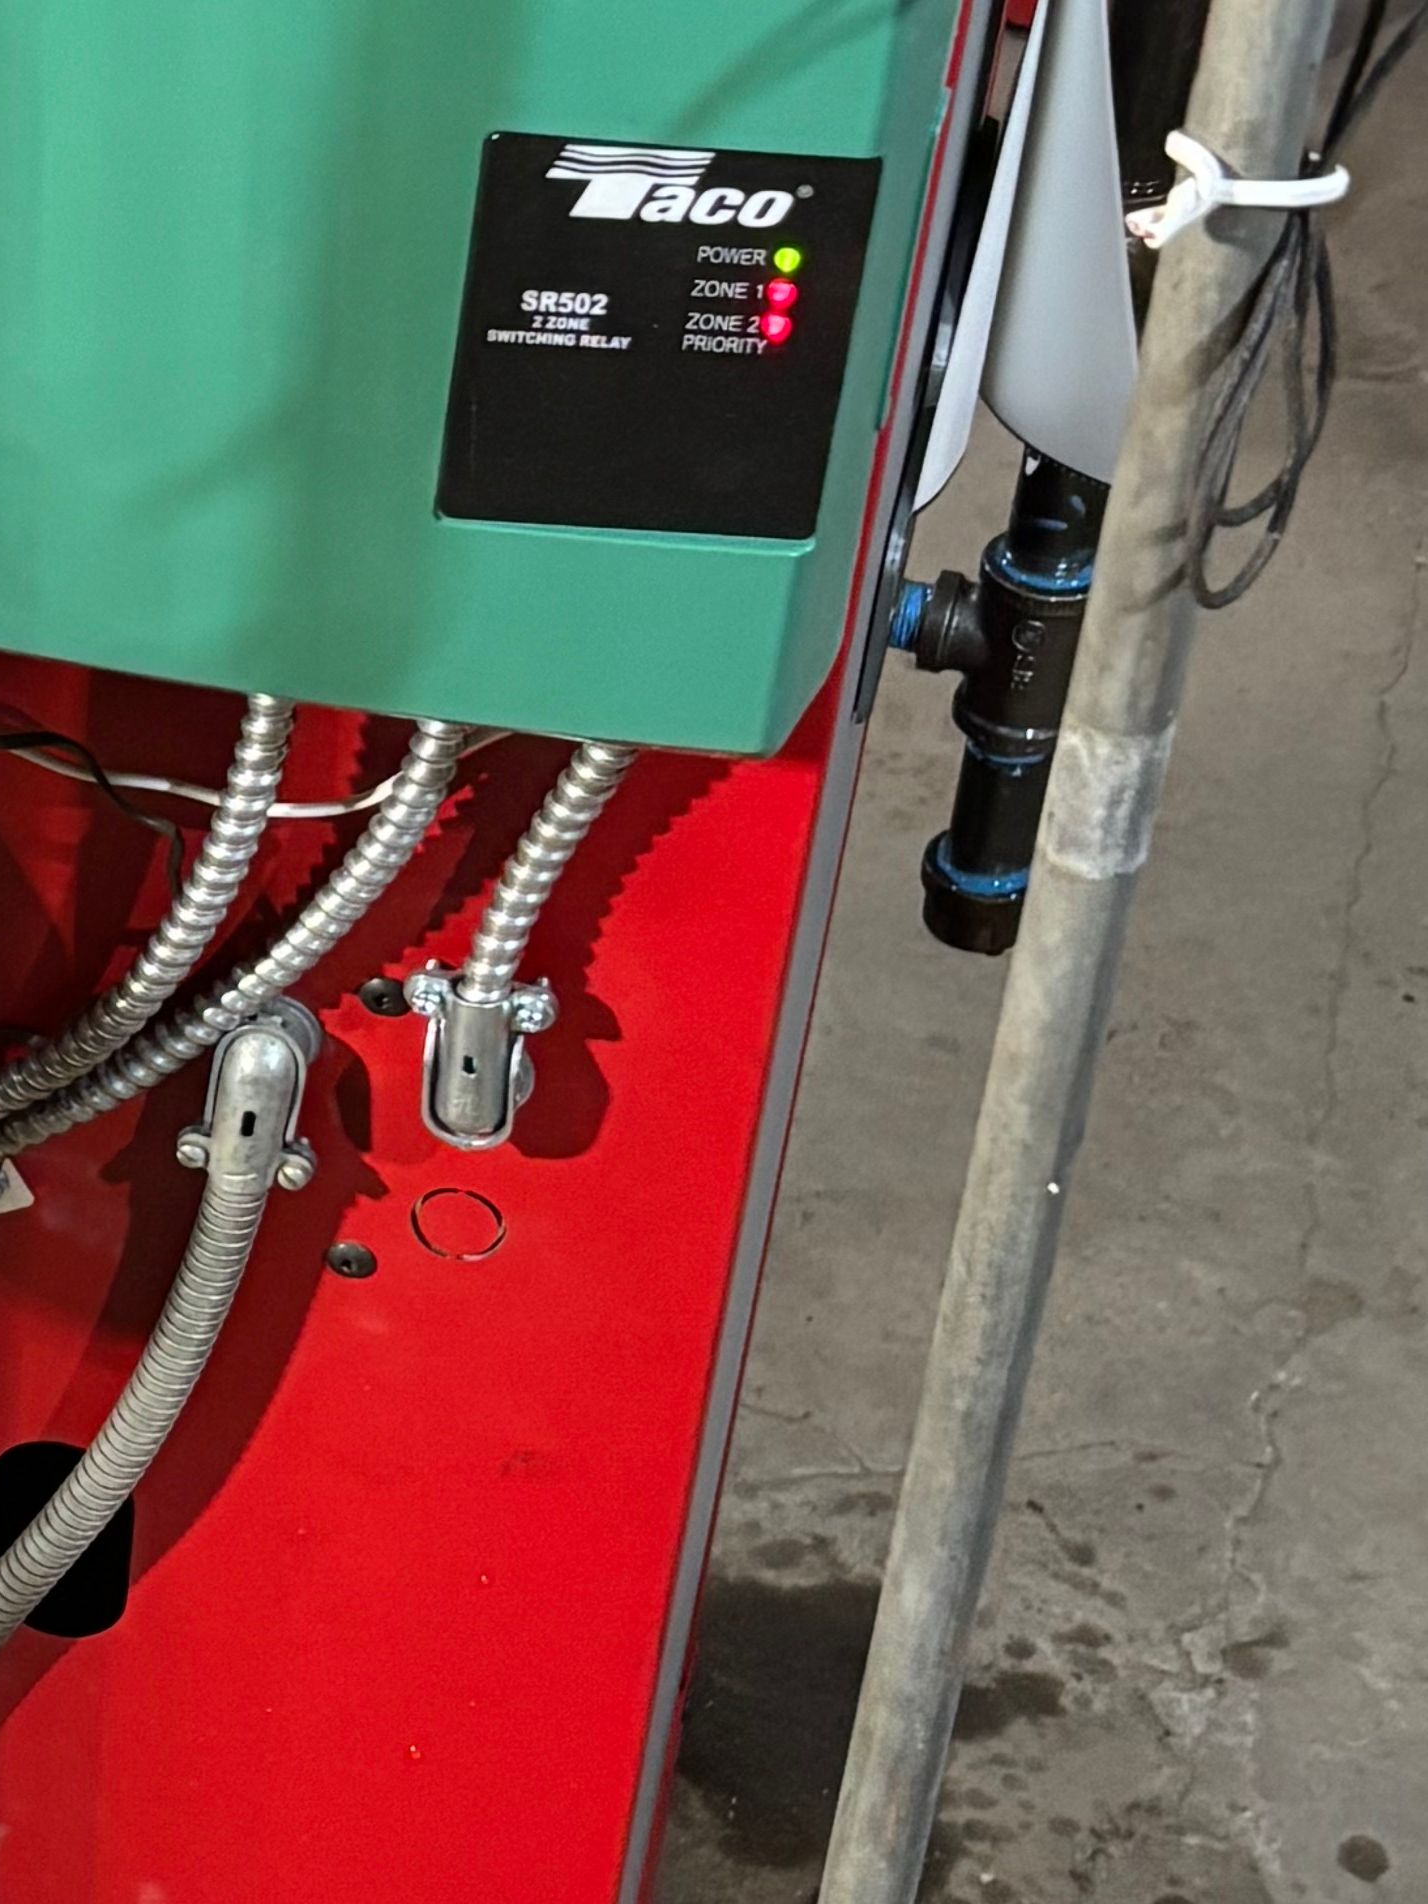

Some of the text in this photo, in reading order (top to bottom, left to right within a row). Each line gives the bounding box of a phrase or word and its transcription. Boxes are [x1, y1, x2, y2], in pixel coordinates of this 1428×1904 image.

[545, 144, 795, 228] Taco
[697, 246, 767, 266] POWER
[691, 280, 764, 299] ZONE 1
[520, 289, 609, 316] SR502
[546, 318, 589, 331] ZONE
[685, 313, 760, 333] ZONE 2
[487, 329, 631, 350] SWITCHING RELAY
[682, 334, 768, 355] PRIORITY
